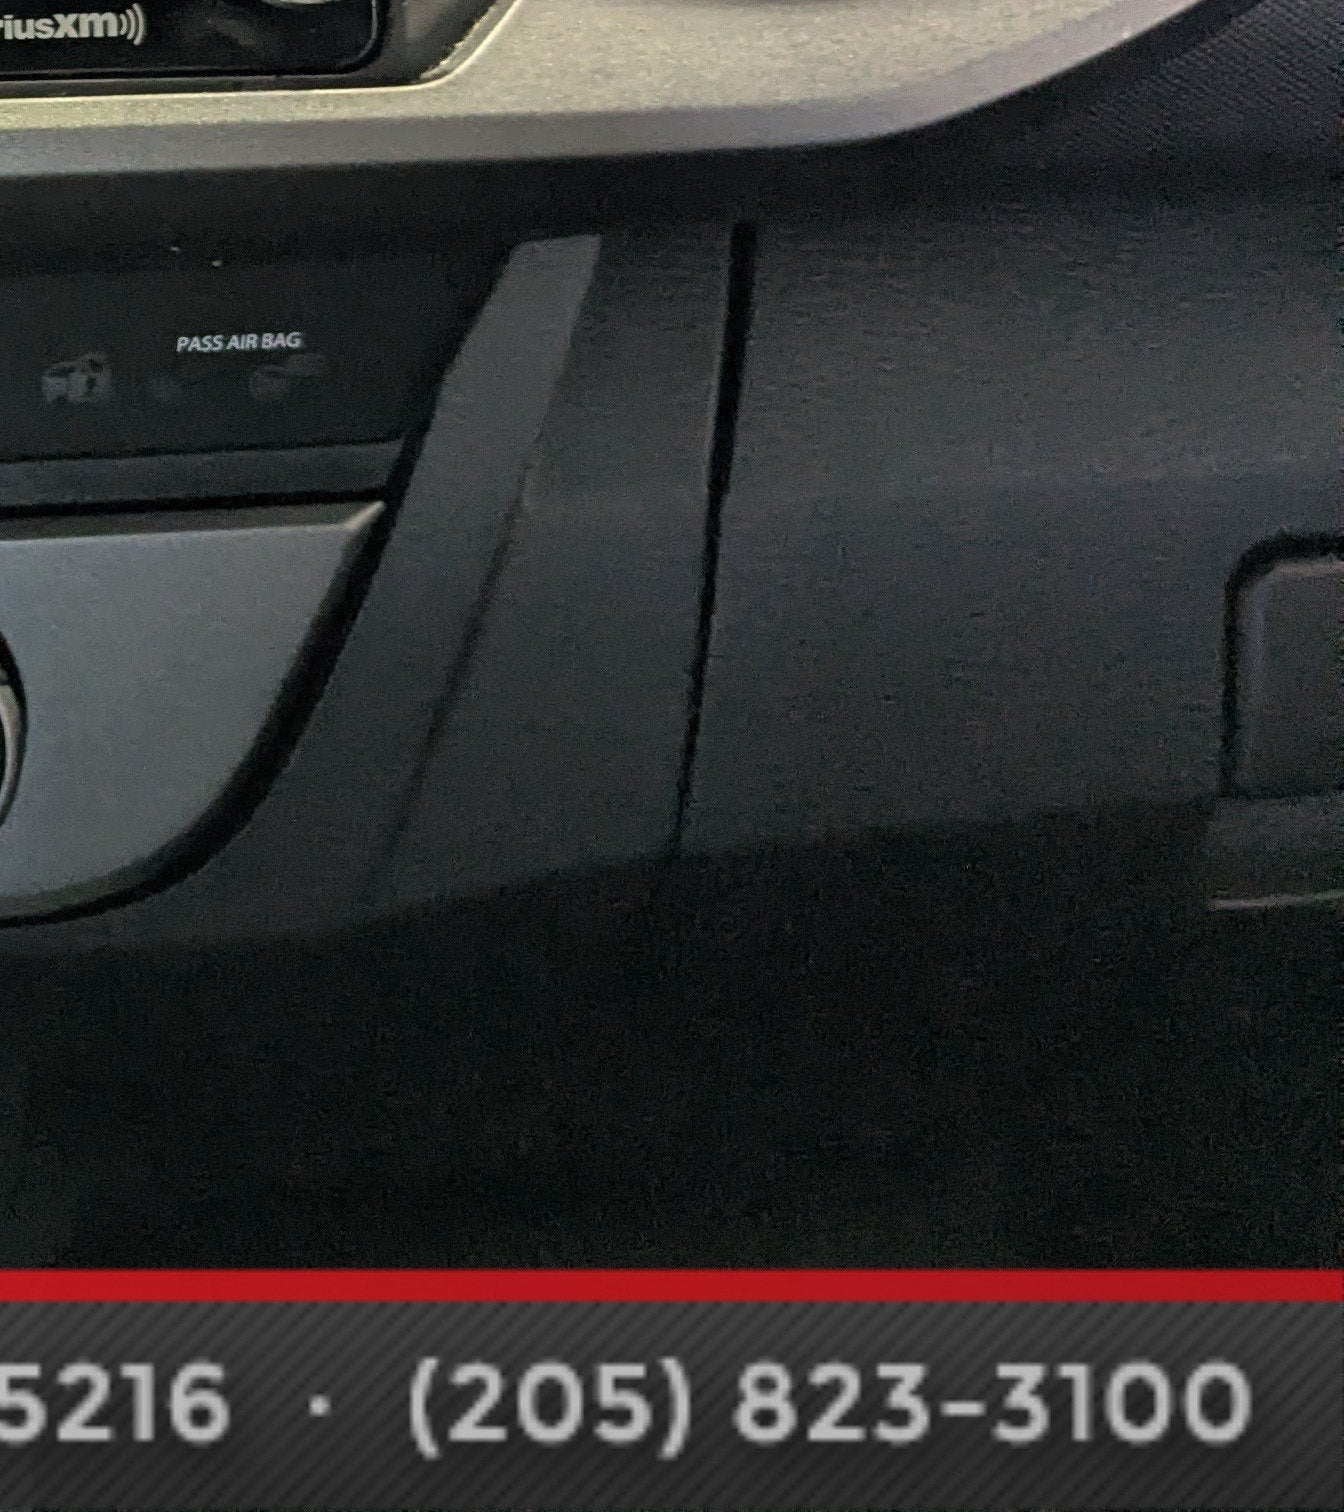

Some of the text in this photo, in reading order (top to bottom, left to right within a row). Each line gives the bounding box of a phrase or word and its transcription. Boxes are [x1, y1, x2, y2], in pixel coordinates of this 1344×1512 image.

[177, 332, 303, 353] PASS AIR BAG
